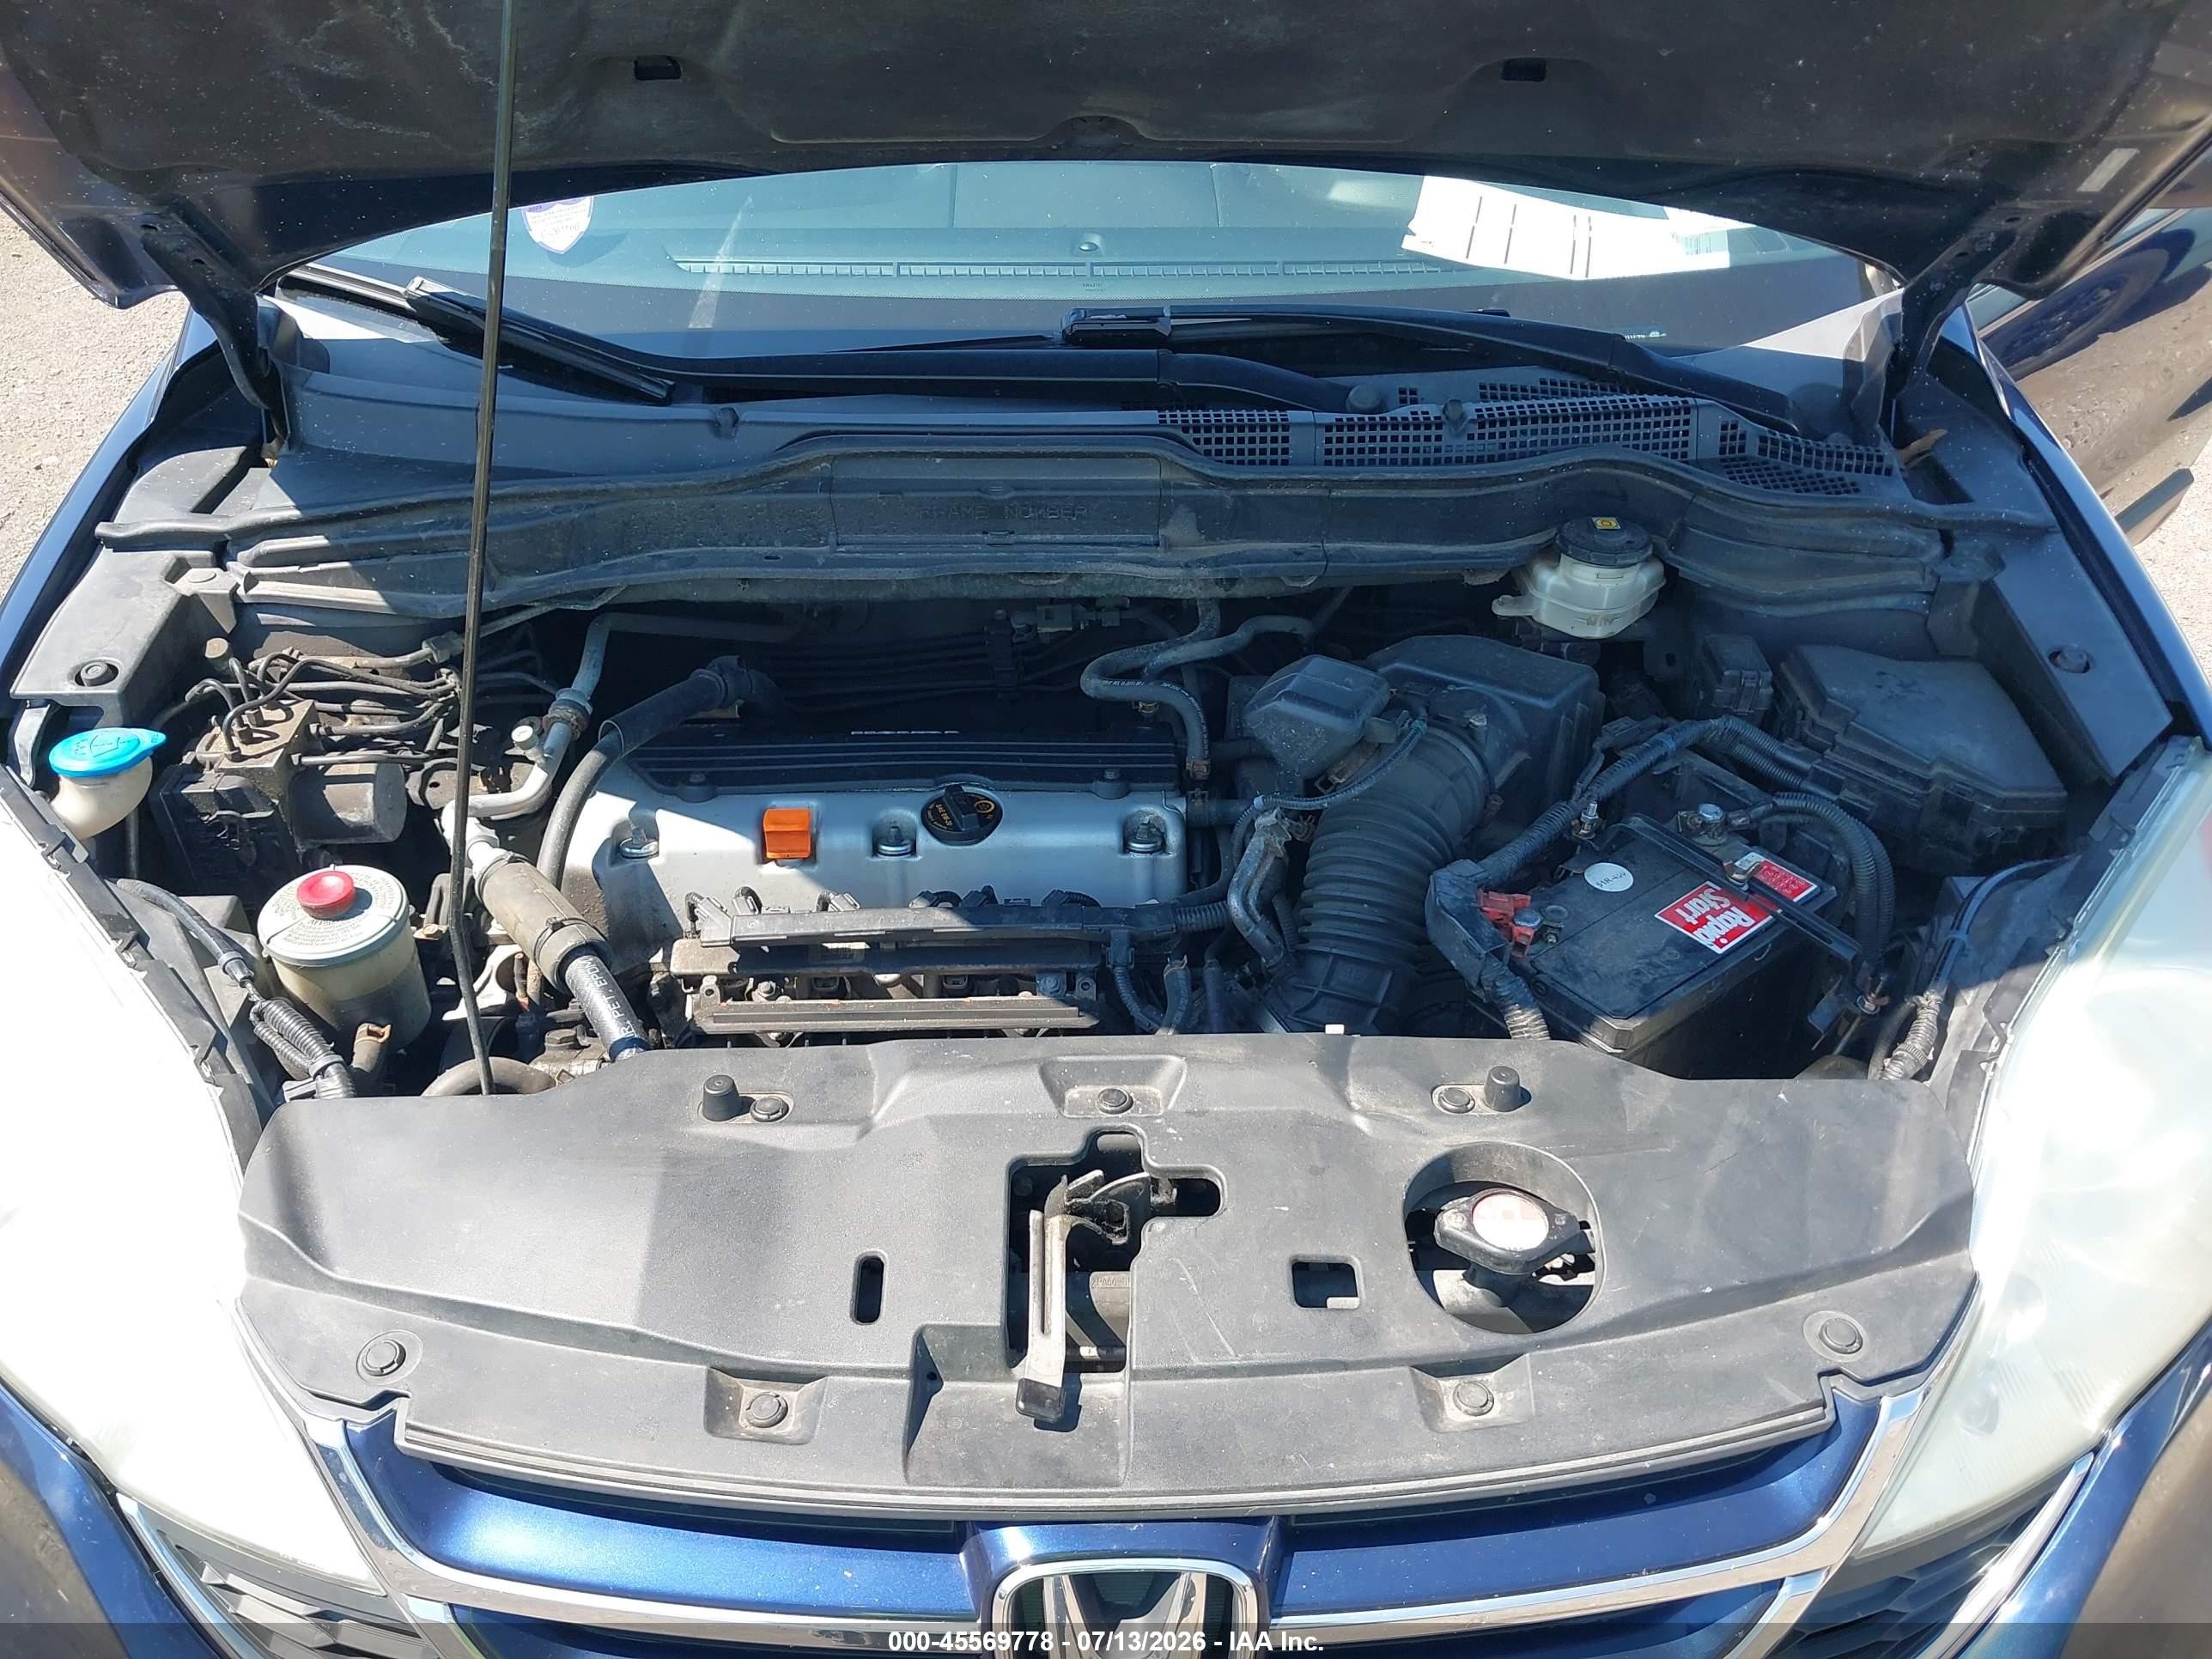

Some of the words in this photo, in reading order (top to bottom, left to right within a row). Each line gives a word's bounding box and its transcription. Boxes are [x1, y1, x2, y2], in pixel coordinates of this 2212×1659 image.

[1674, 887, 1731, 926] Start
[1692, 906, 1756, 945] Rapid
[585, 960, 608, 988] EPDM
